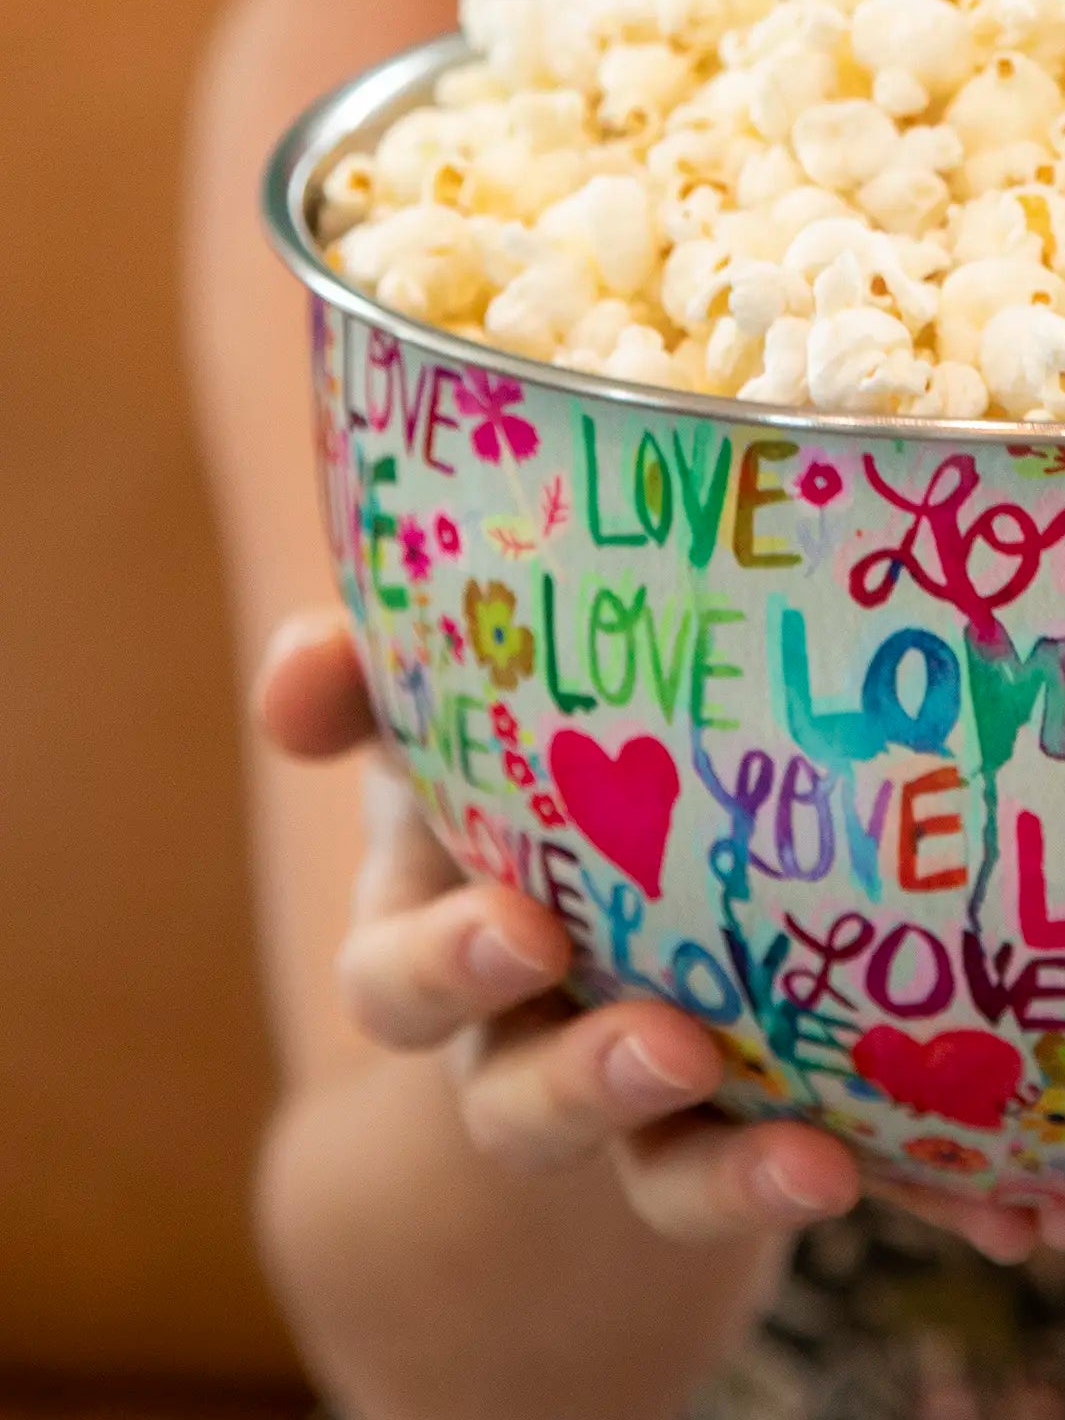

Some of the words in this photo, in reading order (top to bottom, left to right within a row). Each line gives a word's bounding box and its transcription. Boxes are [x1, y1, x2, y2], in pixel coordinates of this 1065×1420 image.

[576, 406, 804, 568] LOVE
[541, 572, 747, 732] LOVE
[695, 745, 968, 903] LOVE
